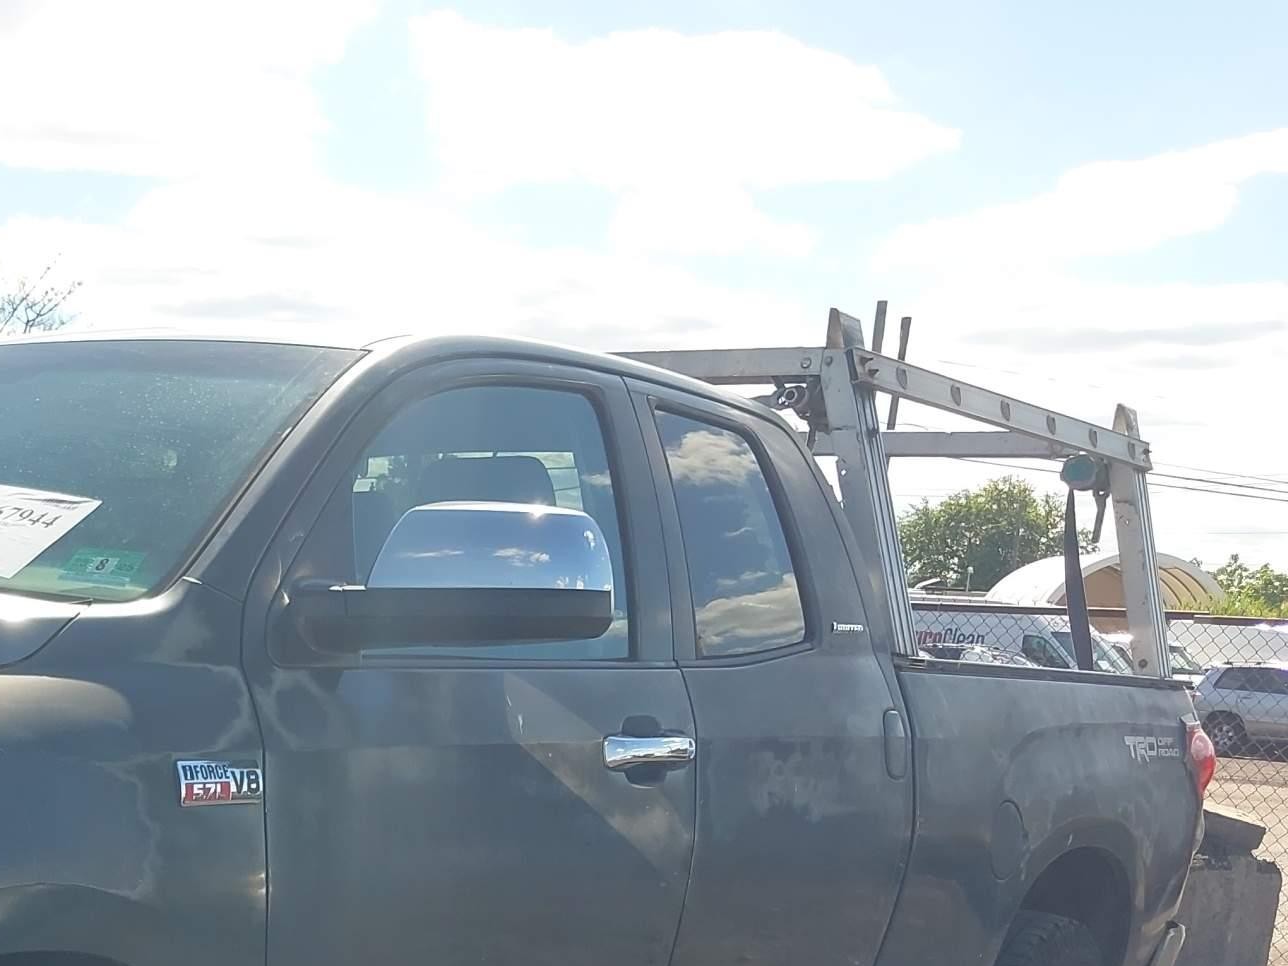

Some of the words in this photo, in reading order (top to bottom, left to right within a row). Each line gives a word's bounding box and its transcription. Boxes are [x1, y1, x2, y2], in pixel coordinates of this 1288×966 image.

[95, 558, 109, 571] 8
[1123, 735, 1158, 764] TRD
[230, 769, 261, 796] V8
